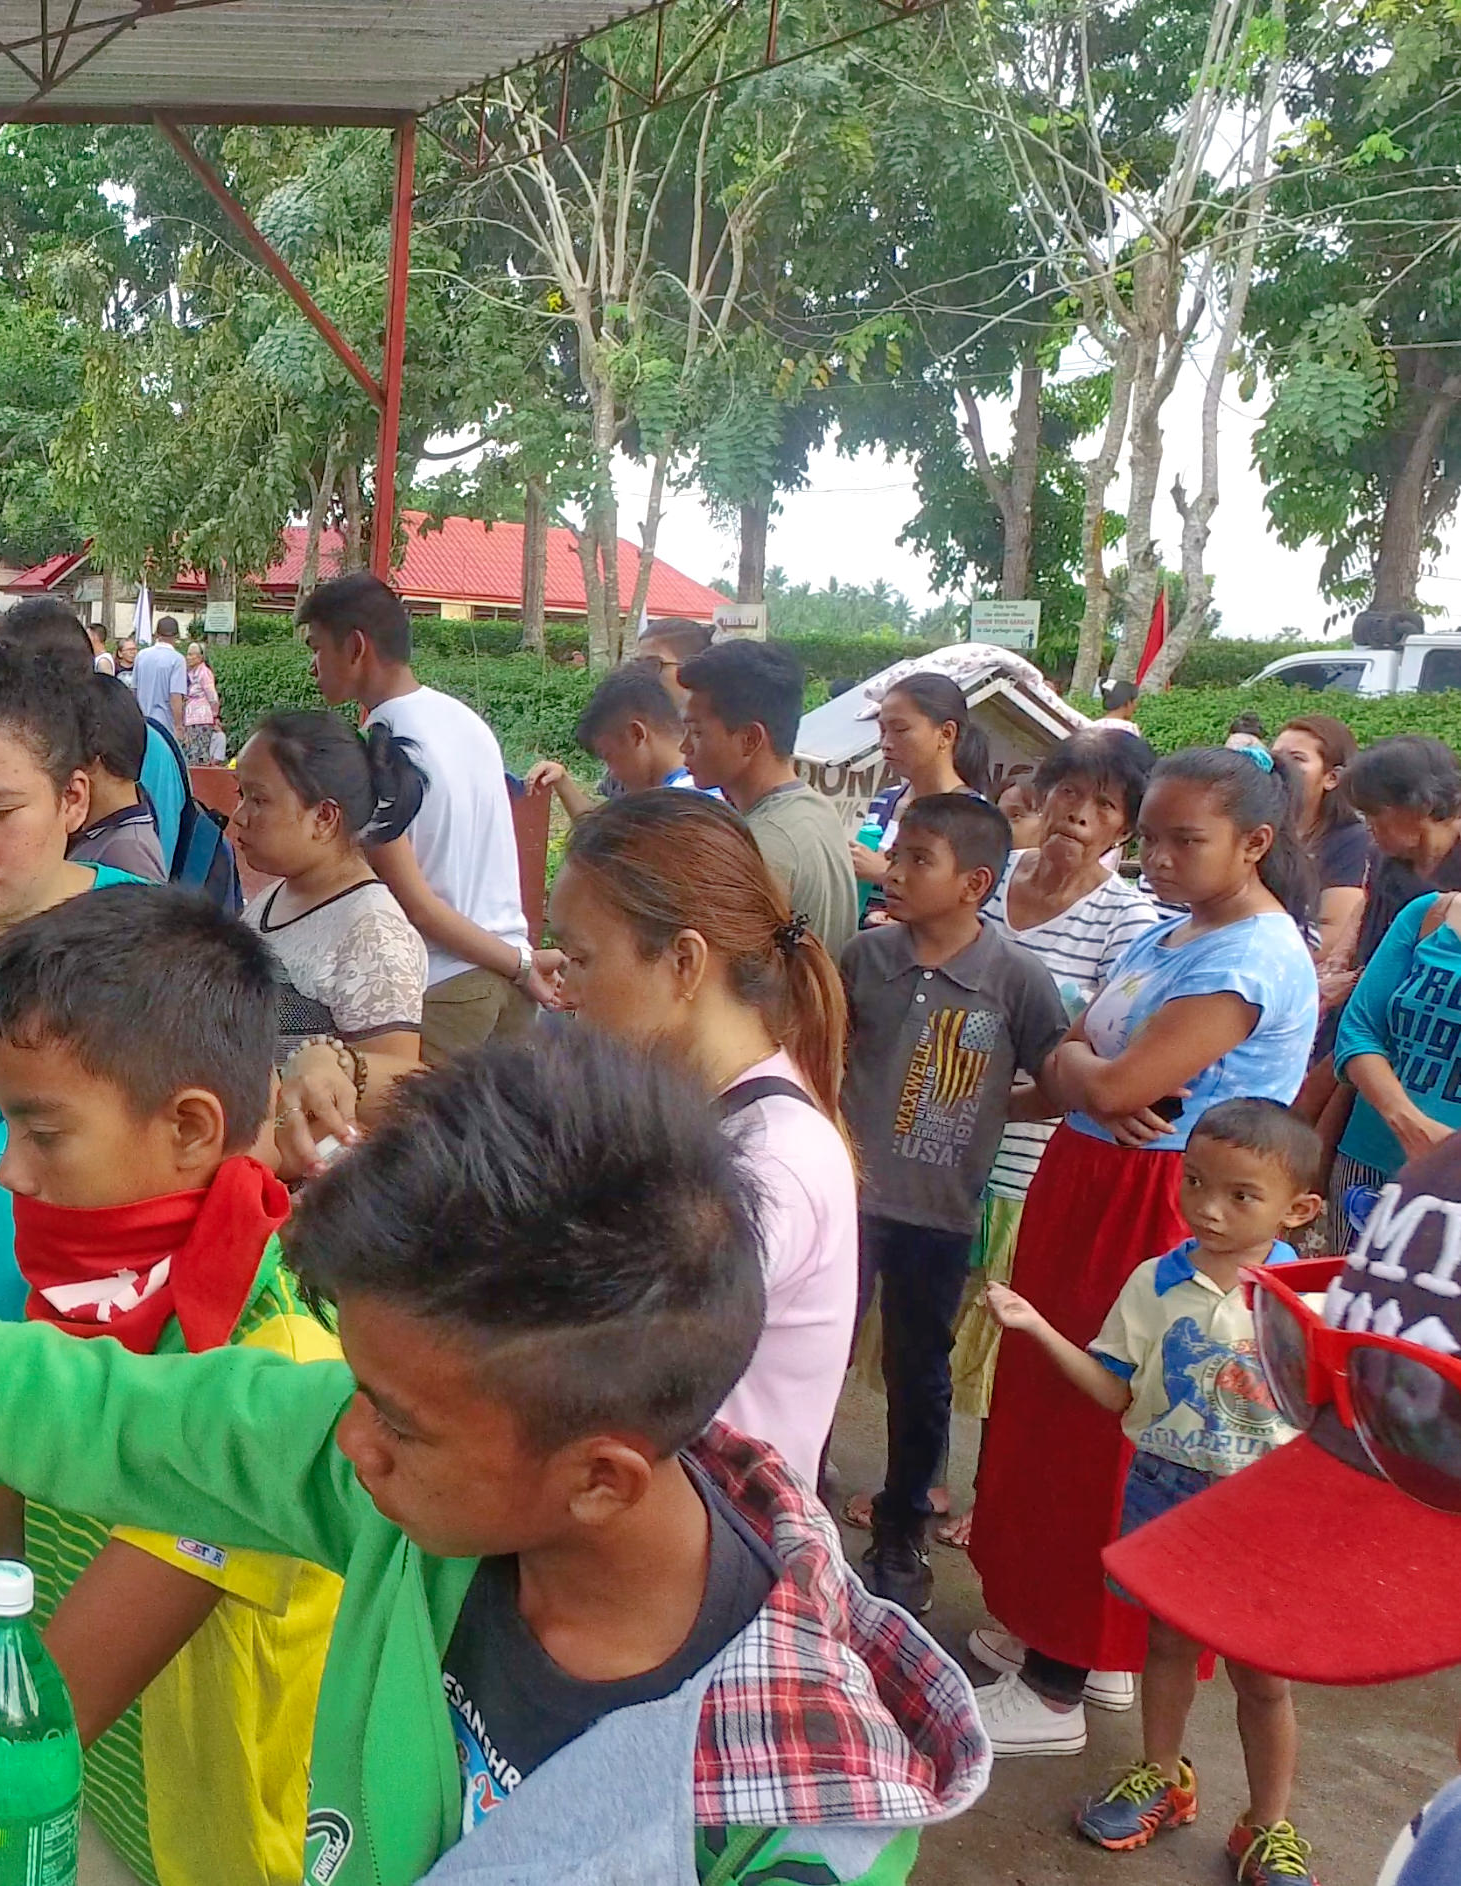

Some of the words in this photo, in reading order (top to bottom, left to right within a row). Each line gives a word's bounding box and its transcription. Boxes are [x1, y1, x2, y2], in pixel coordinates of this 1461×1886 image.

[895, 1043, 933, 1135] MAXWELL
[953, 1099, 980, 1146] 1972
[900, 1134, 954, 1167] USA
